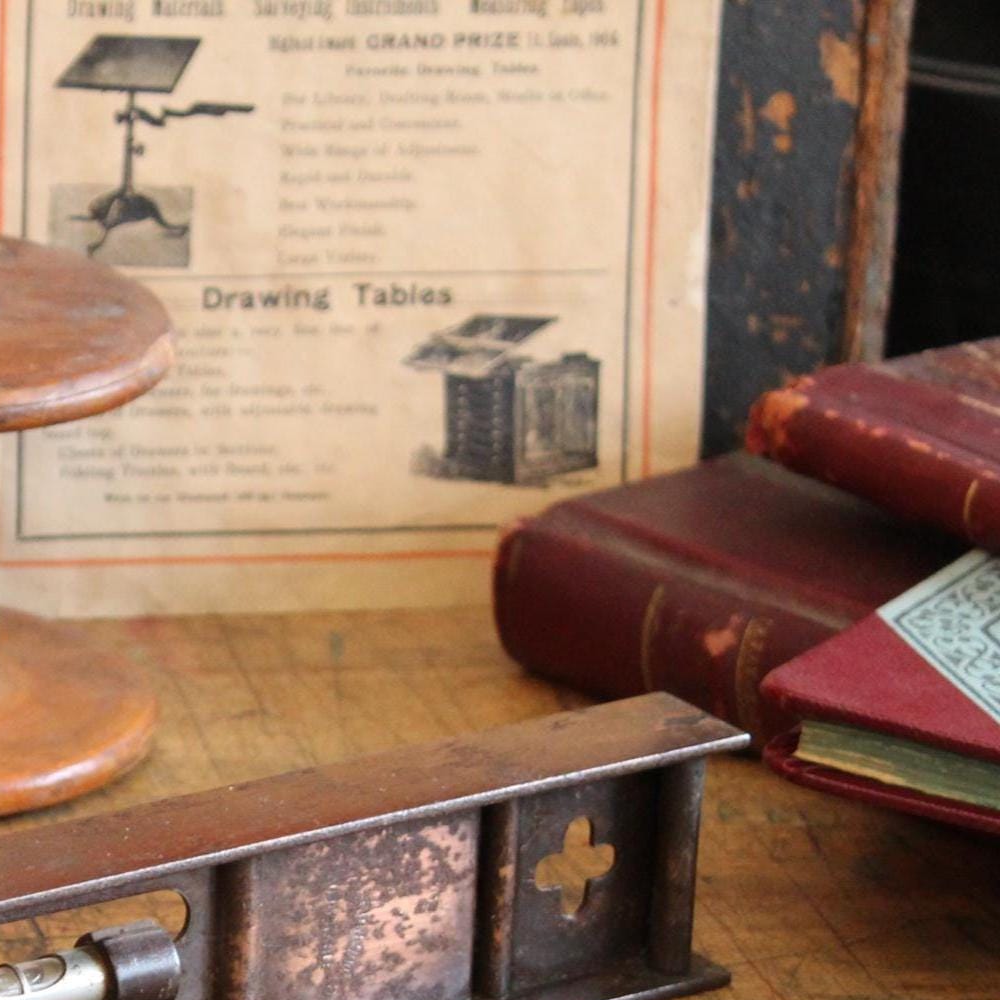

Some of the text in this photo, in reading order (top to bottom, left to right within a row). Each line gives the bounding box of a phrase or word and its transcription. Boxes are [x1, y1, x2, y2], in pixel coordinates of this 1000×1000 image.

[366, 32, 444, 49] GRAND
[453, 31, 519, 49] PRIZE
[201, 281, 453, 313] Drawing Tables
